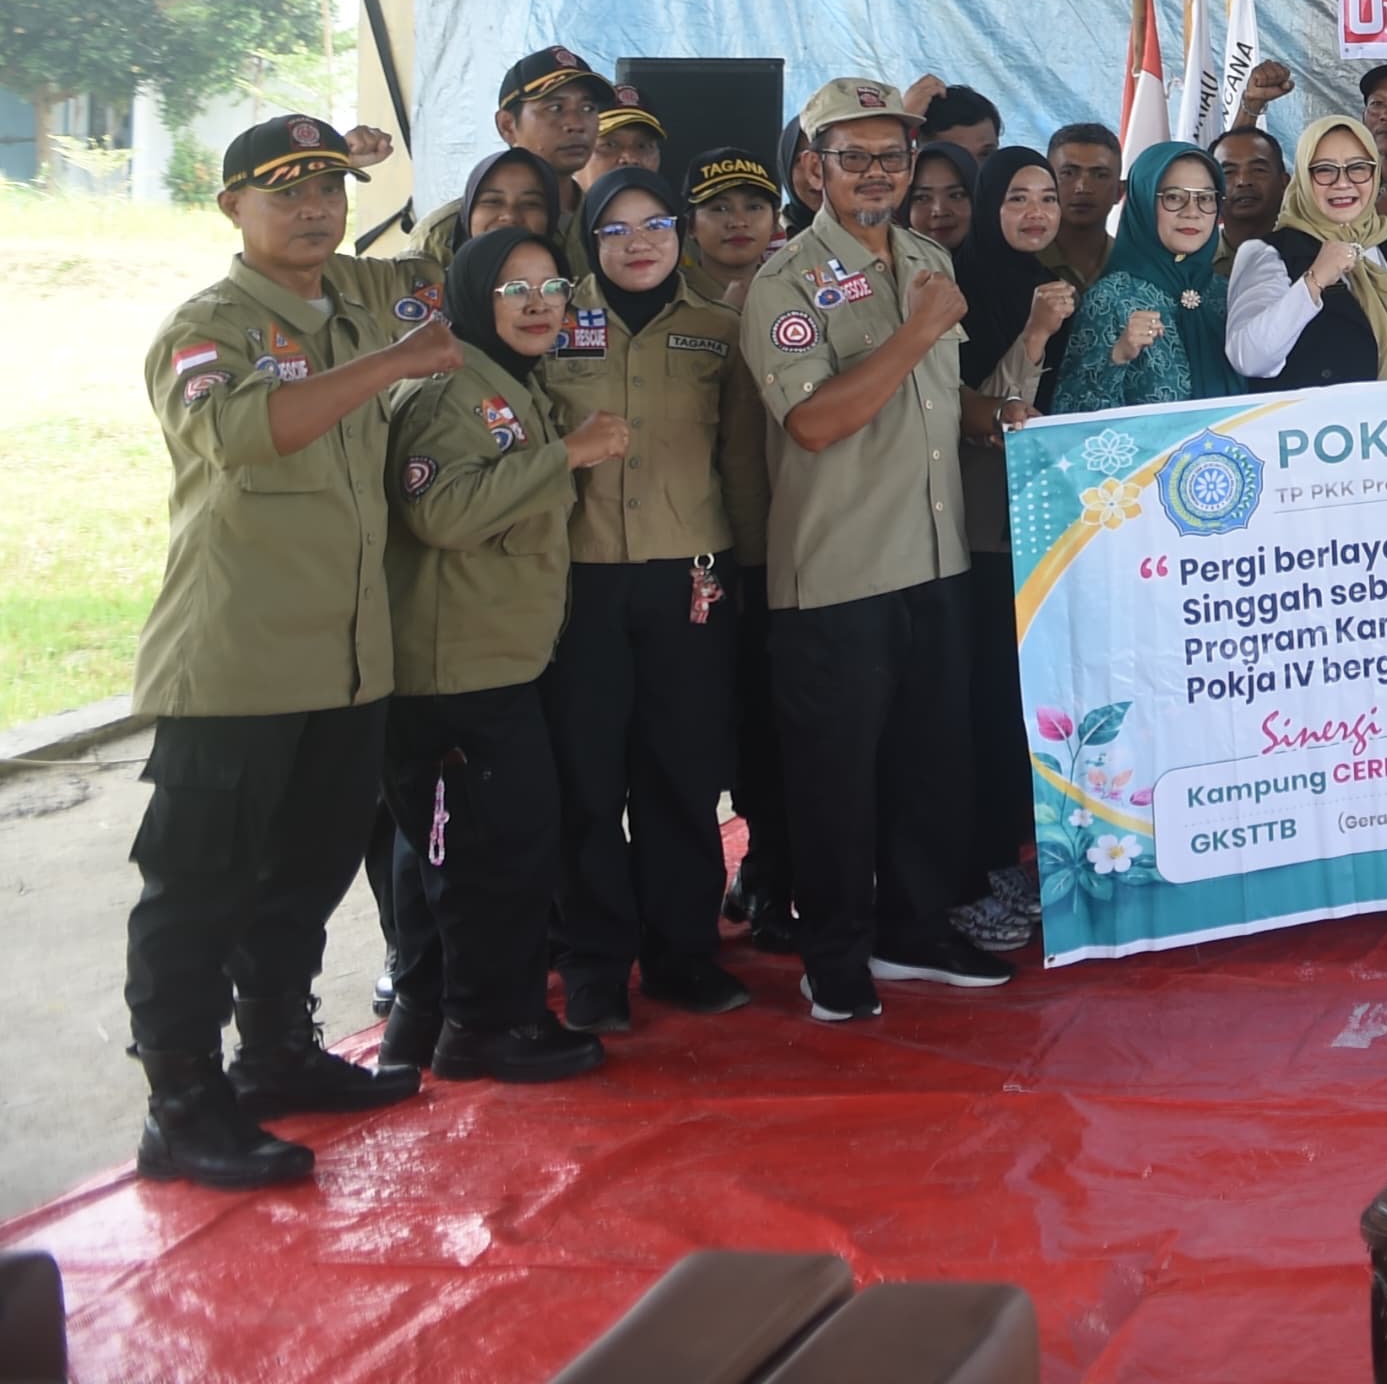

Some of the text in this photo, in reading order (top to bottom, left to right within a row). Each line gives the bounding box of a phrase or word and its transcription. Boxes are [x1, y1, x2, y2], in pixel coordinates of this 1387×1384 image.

[701, 158, 769, 179] TAGANA
[574, 328, 606, 348] RESCUE
[673, 336, 723, 354] TAGANA
[1275, 486, 1303, 505] TP
[1310, 479, 1355, 500] PKK
[1179, 543, 1267, 586] Pergi
[1182, 580, 1323, 626] Singgah
[1184, 623, 1329, 668] Program
[1186, 662, 1276, 706] Pokja
[1284, 658, 1315, 691] IV
[1260, 707, 1383, 756] Sinergi
[1187, 766, 1328, 810] Kampung
[1190, 817, 1298, 855] GKSTTB
